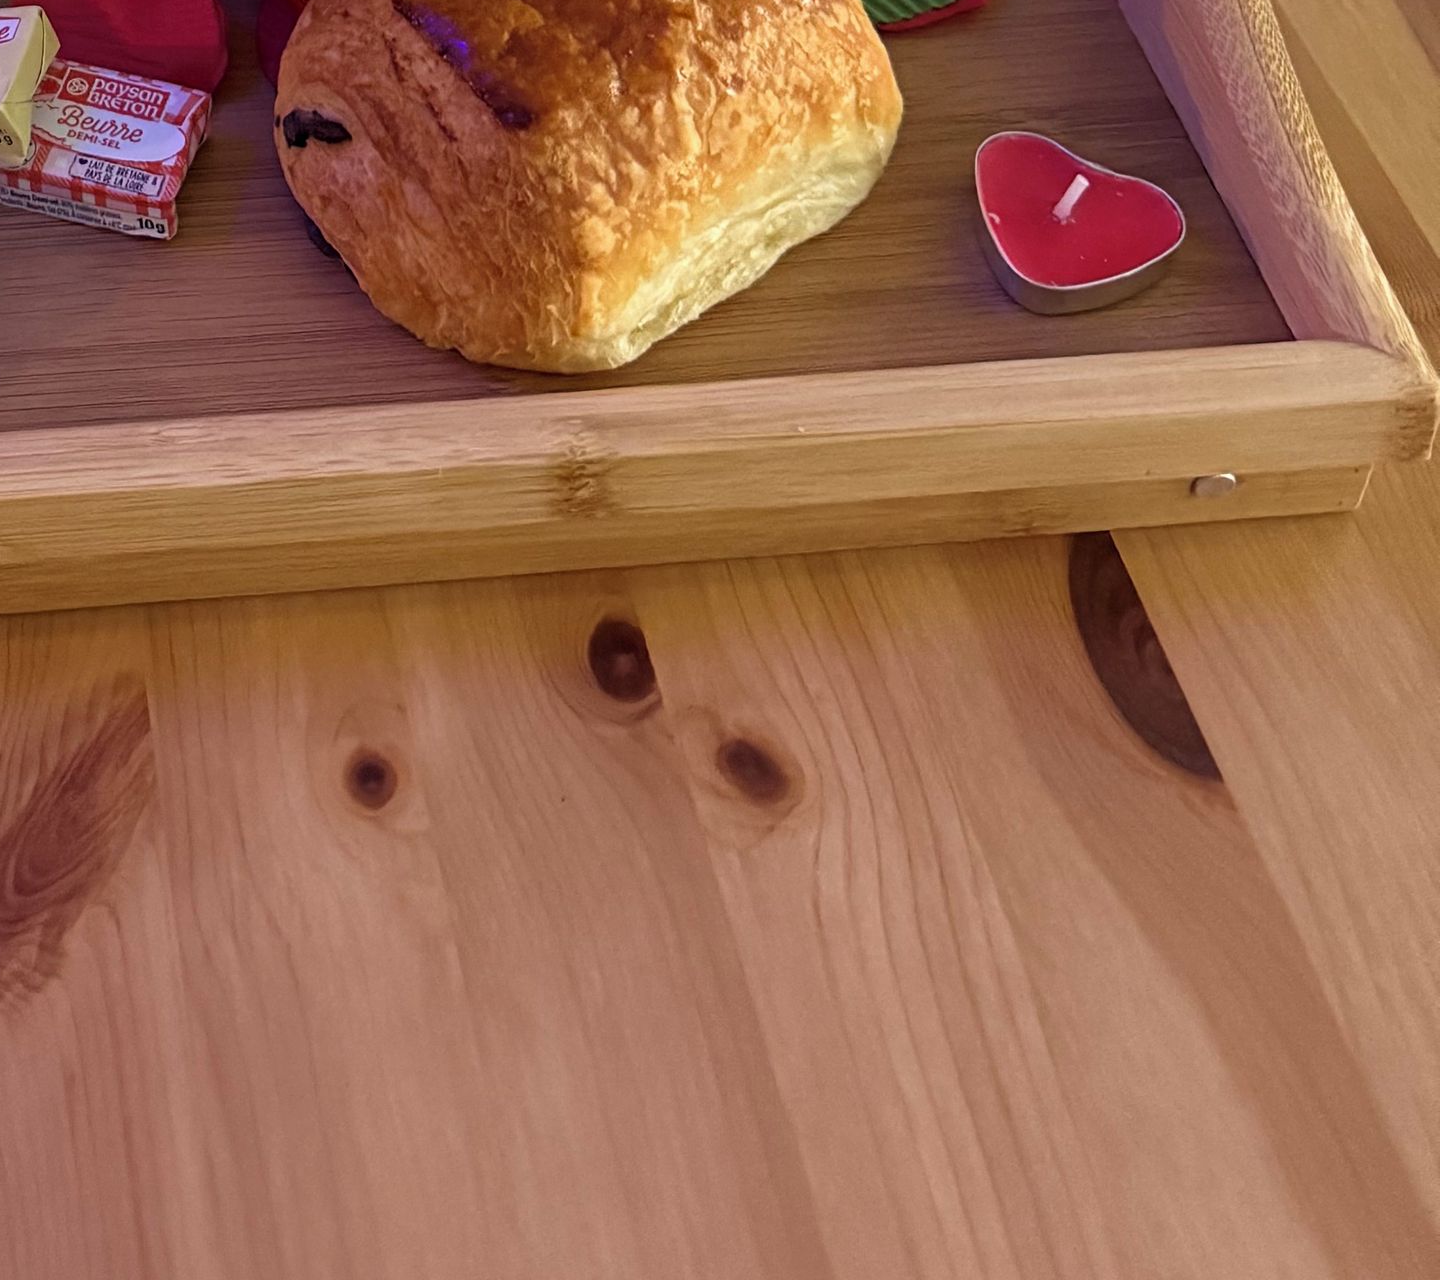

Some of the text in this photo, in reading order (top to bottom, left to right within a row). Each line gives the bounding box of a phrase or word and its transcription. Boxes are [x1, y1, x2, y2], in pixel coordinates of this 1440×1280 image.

[57, 104, 144, 143] Beurre
[67, 129, 121, 150] DEMI-SEL
[84, 168, 145, 192] PAYS DE LA LOIRE
[88, 160, 104, 170] LAIT
[105, 163, 114, 174] DE
[116, 167, 150, 184] BRETAGNE
